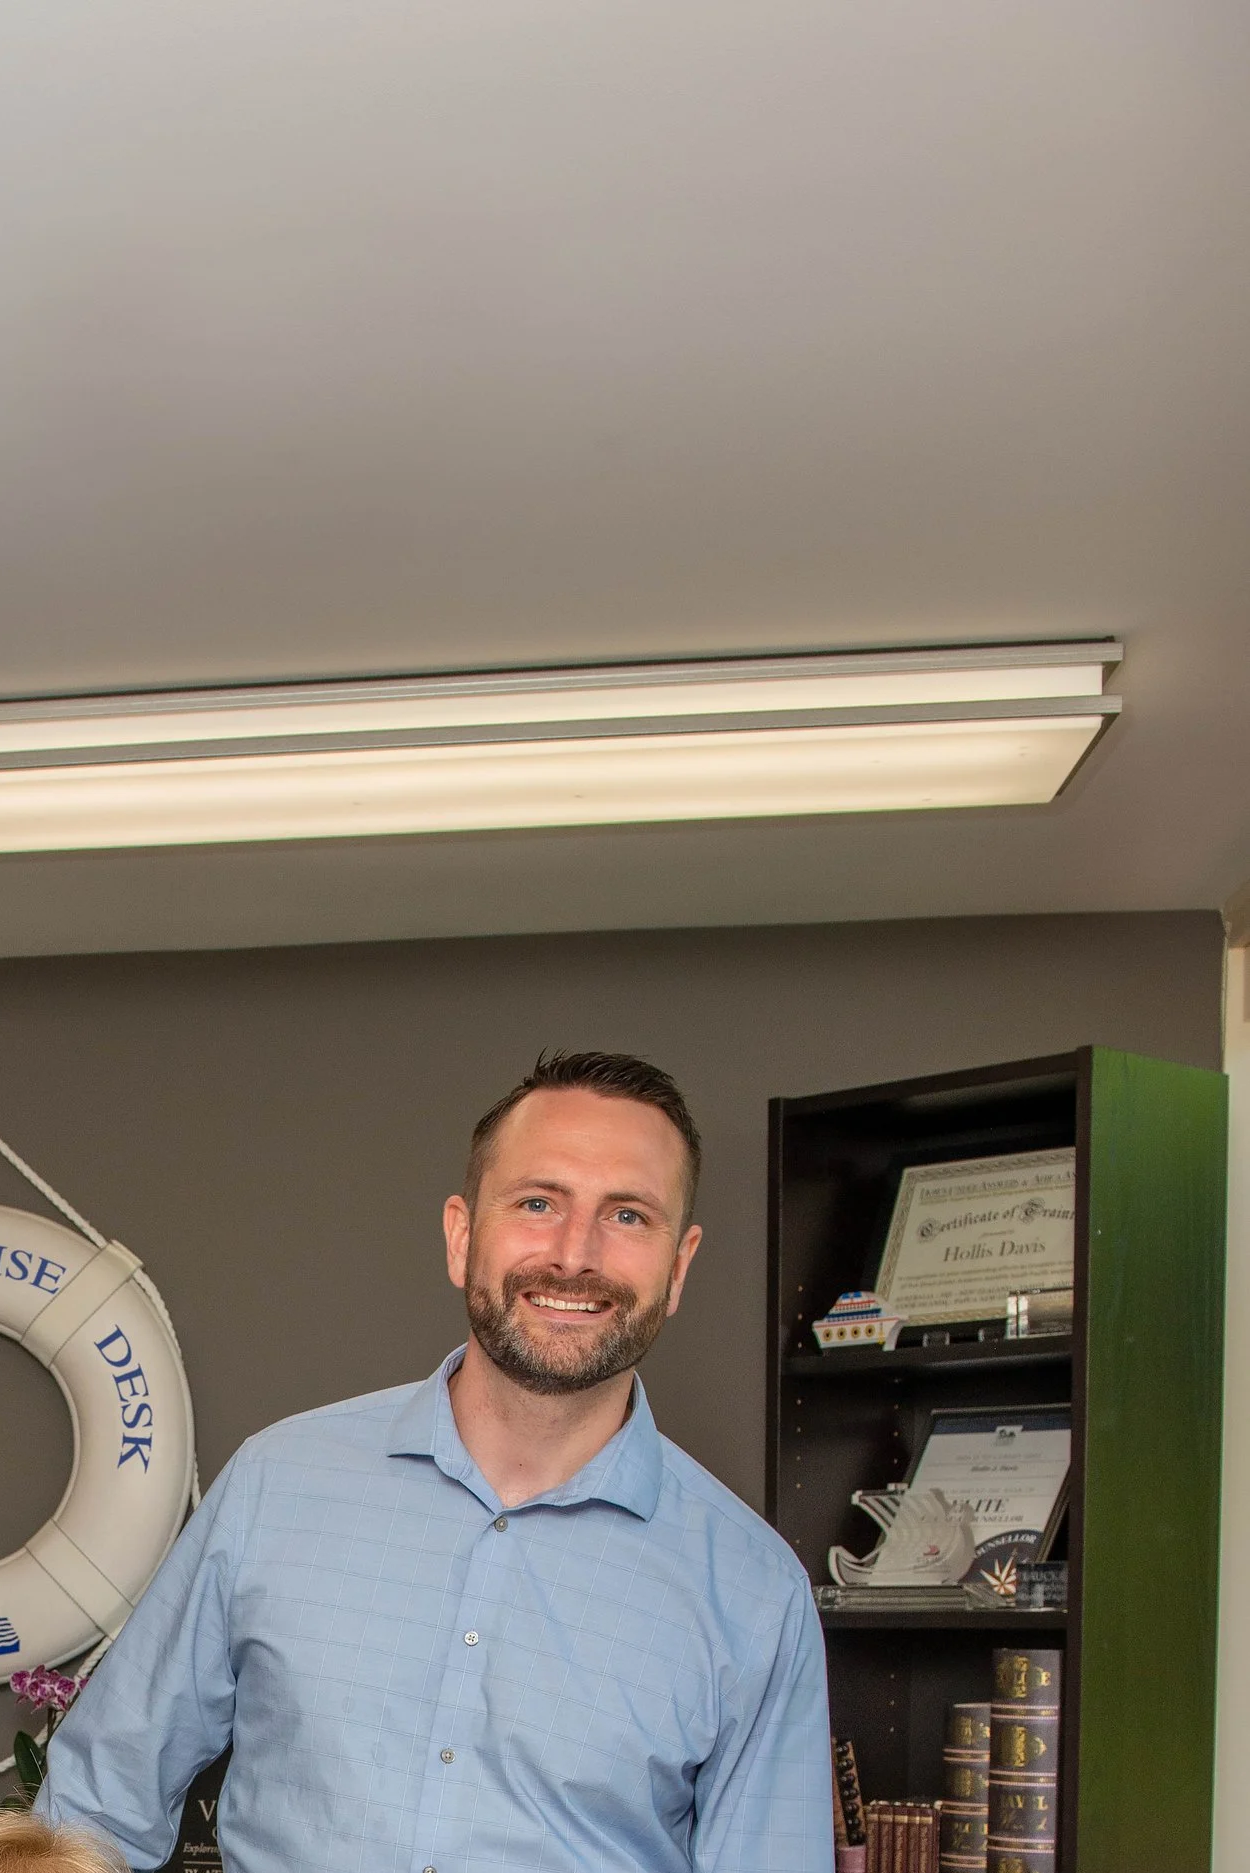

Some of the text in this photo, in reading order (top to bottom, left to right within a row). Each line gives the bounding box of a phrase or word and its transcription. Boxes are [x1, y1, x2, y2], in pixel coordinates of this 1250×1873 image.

[916, 1210, 999, 1244] Certificate
[943, 1238, 1046, 1262] Hollis Davis
[93, 1325, 152, 1474] DESK
